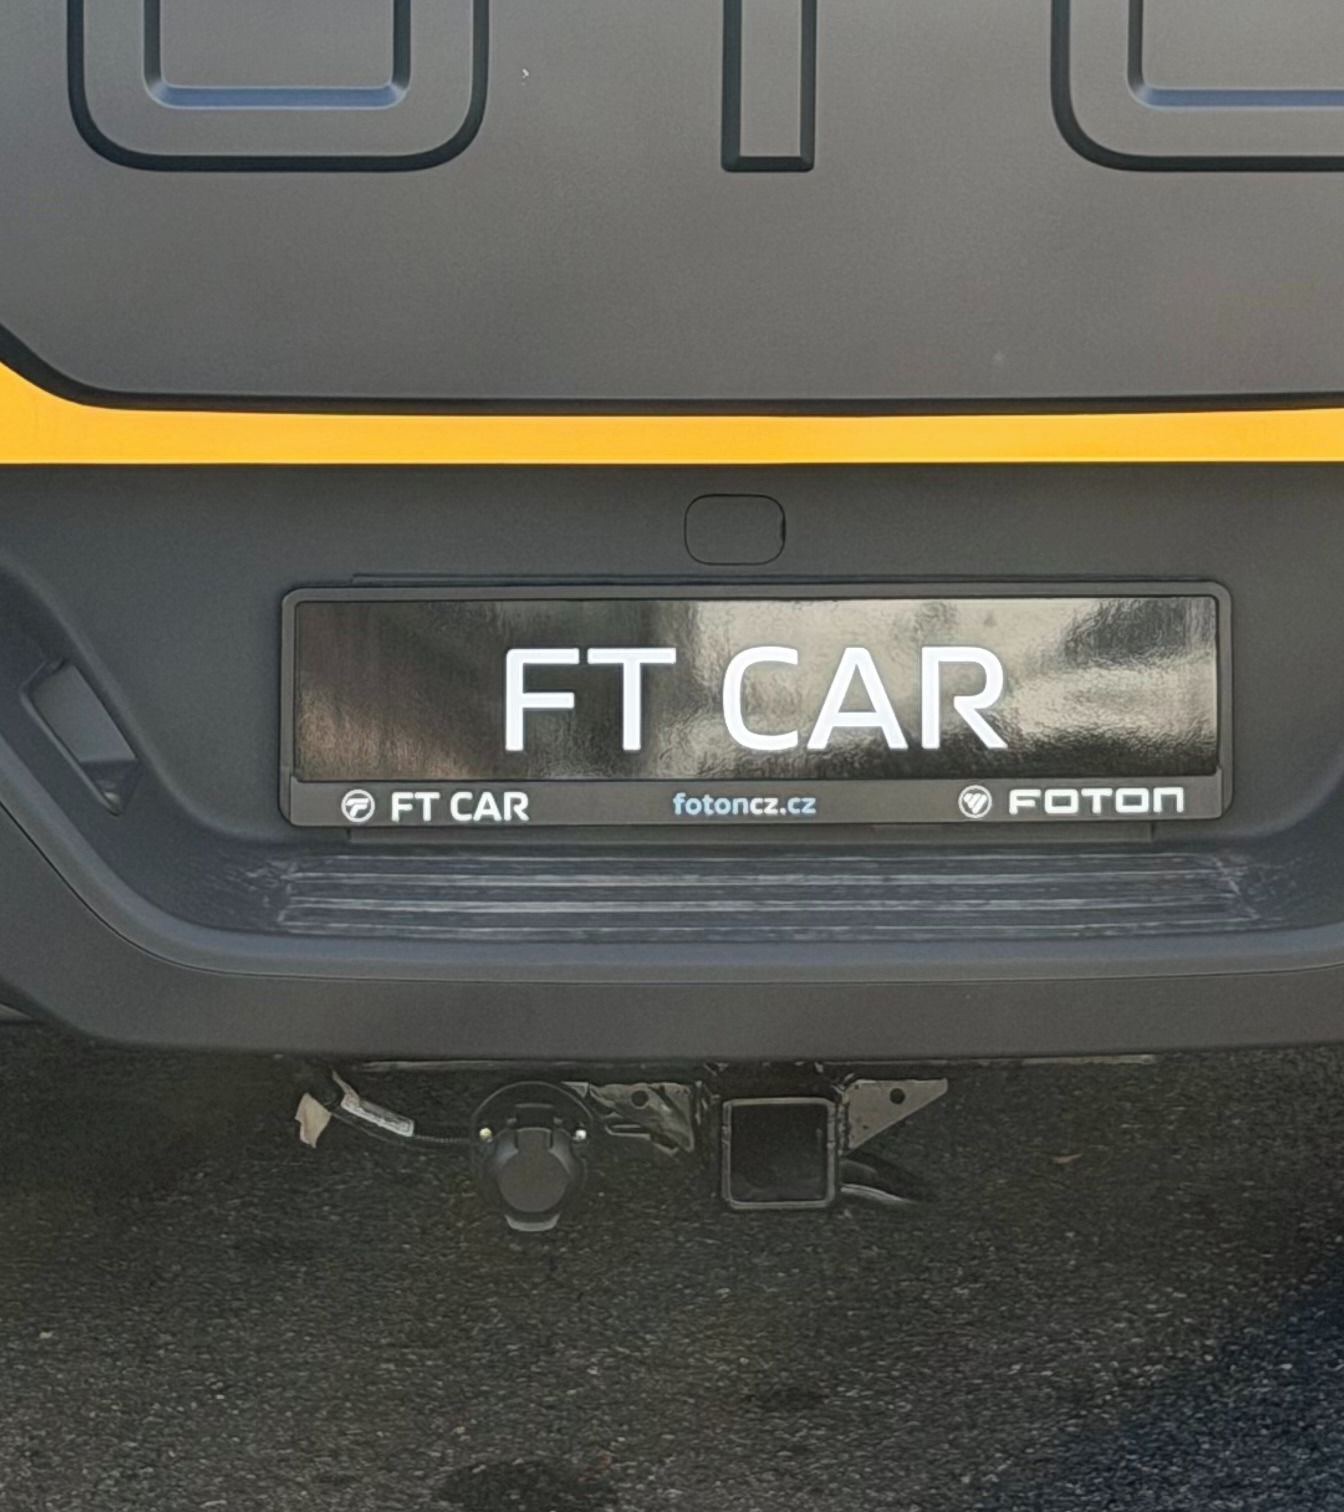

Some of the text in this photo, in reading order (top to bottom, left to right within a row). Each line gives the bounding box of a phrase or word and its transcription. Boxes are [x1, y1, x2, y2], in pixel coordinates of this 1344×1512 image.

[504, 645, 1008, 752] FT CAR
[391, 791, 530, 822] FT CAR
[672, 792, 817, 816] fotoncz.cz
[1008, 786, 1184, 816] FOTON
